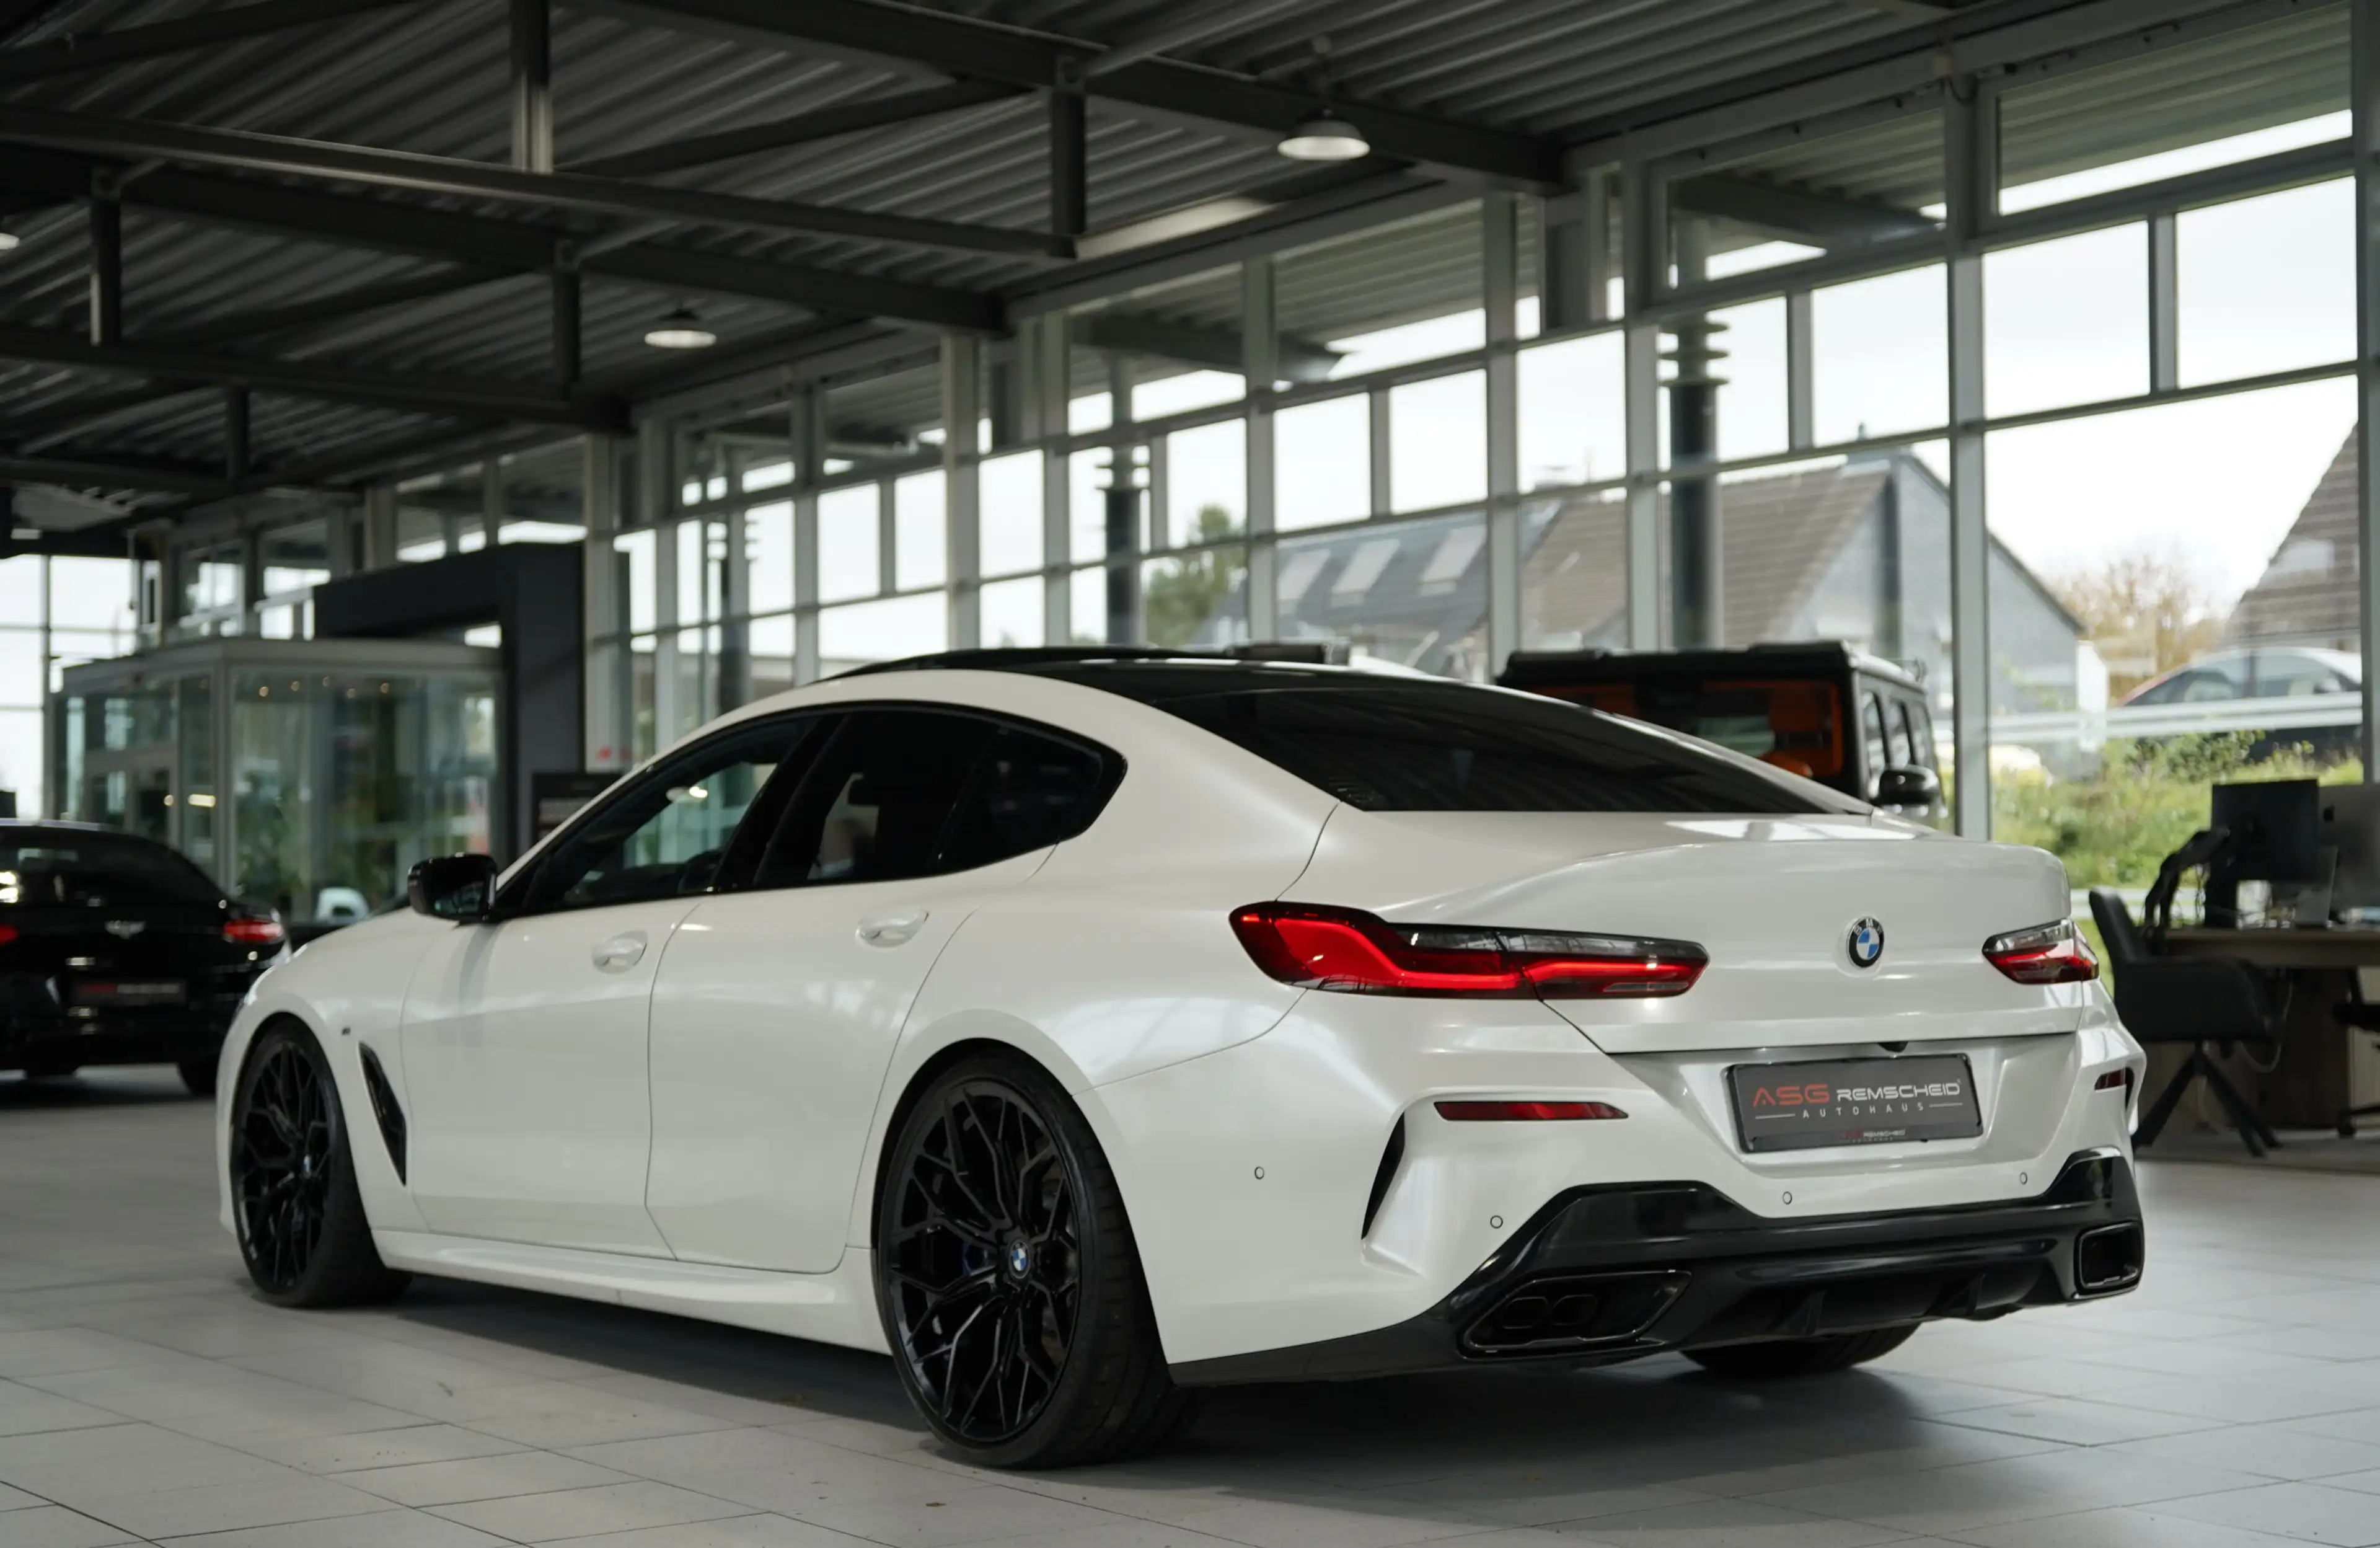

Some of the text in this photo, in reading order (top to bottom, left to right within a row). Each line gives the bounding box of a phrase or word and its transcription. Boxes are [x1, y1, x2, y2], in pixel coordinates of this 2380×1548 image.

[1753, 1082, 1960, 1107] ASG REMSCHEID
[1802, 1102, 1924, 1119] AUTOHAUS
